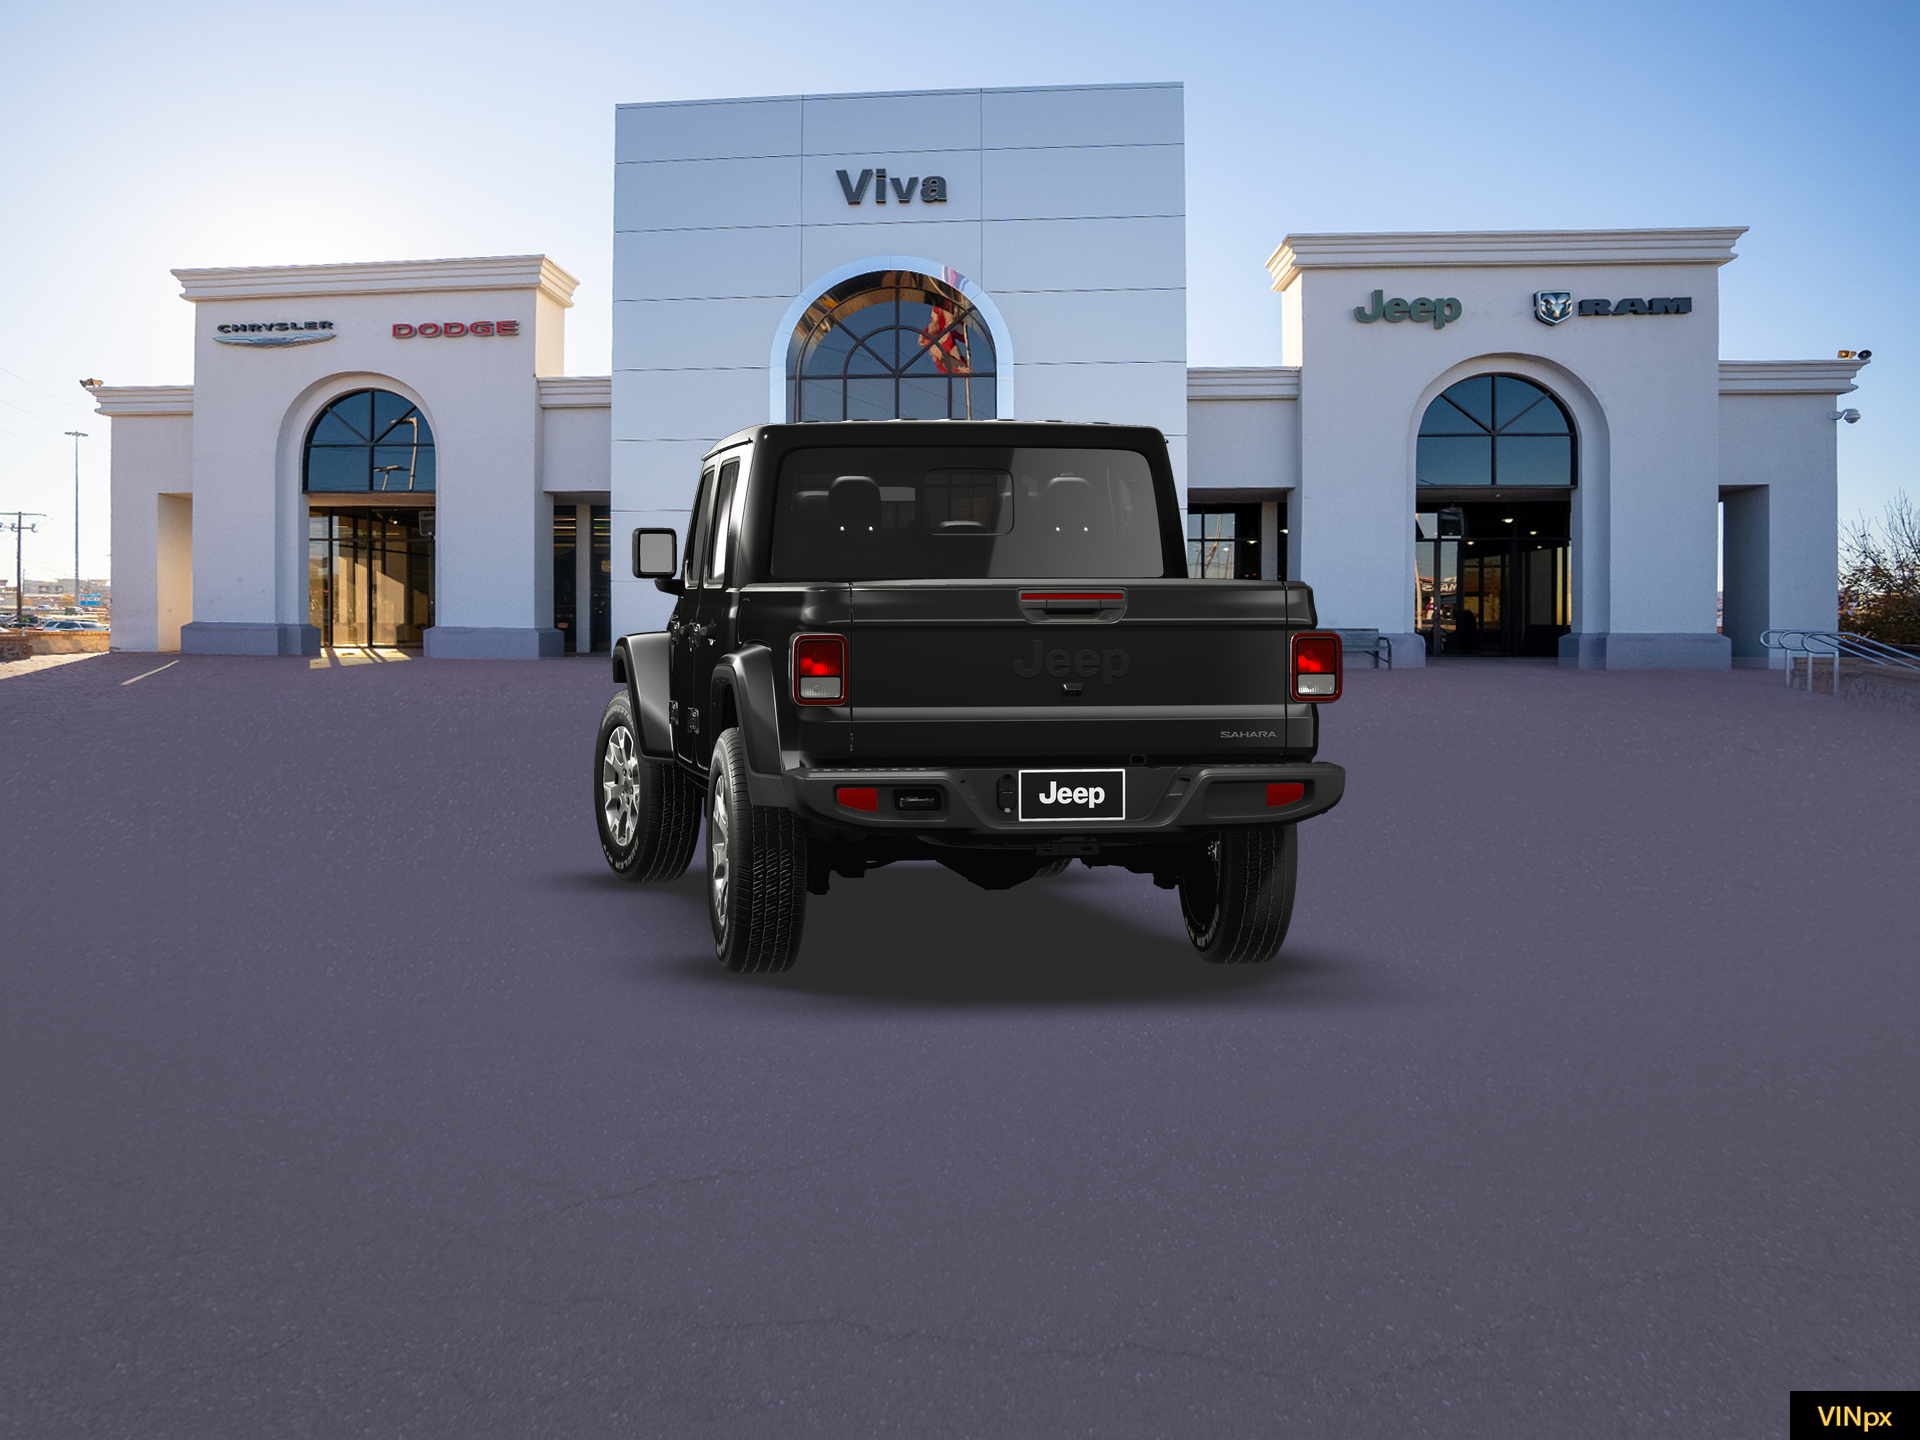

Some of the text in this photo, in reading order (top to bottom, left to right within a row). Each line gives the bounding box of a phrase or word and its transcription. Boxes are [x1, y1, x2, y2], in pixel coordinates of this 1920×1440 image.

[835, 168, 947, 205] Viva
[1353, 289, 1462, 329] Jeep
[1578, 297, 1692, 316] RAM
[217, 321, 334, 333] CHRYSLER
[392, 319, 519, 338] DODGE
[1012, 640, 1130, 686] Jeep
[1220, 731, 1277, 739] SAHARA
[1038, 781, 1105, 809] Jeep
